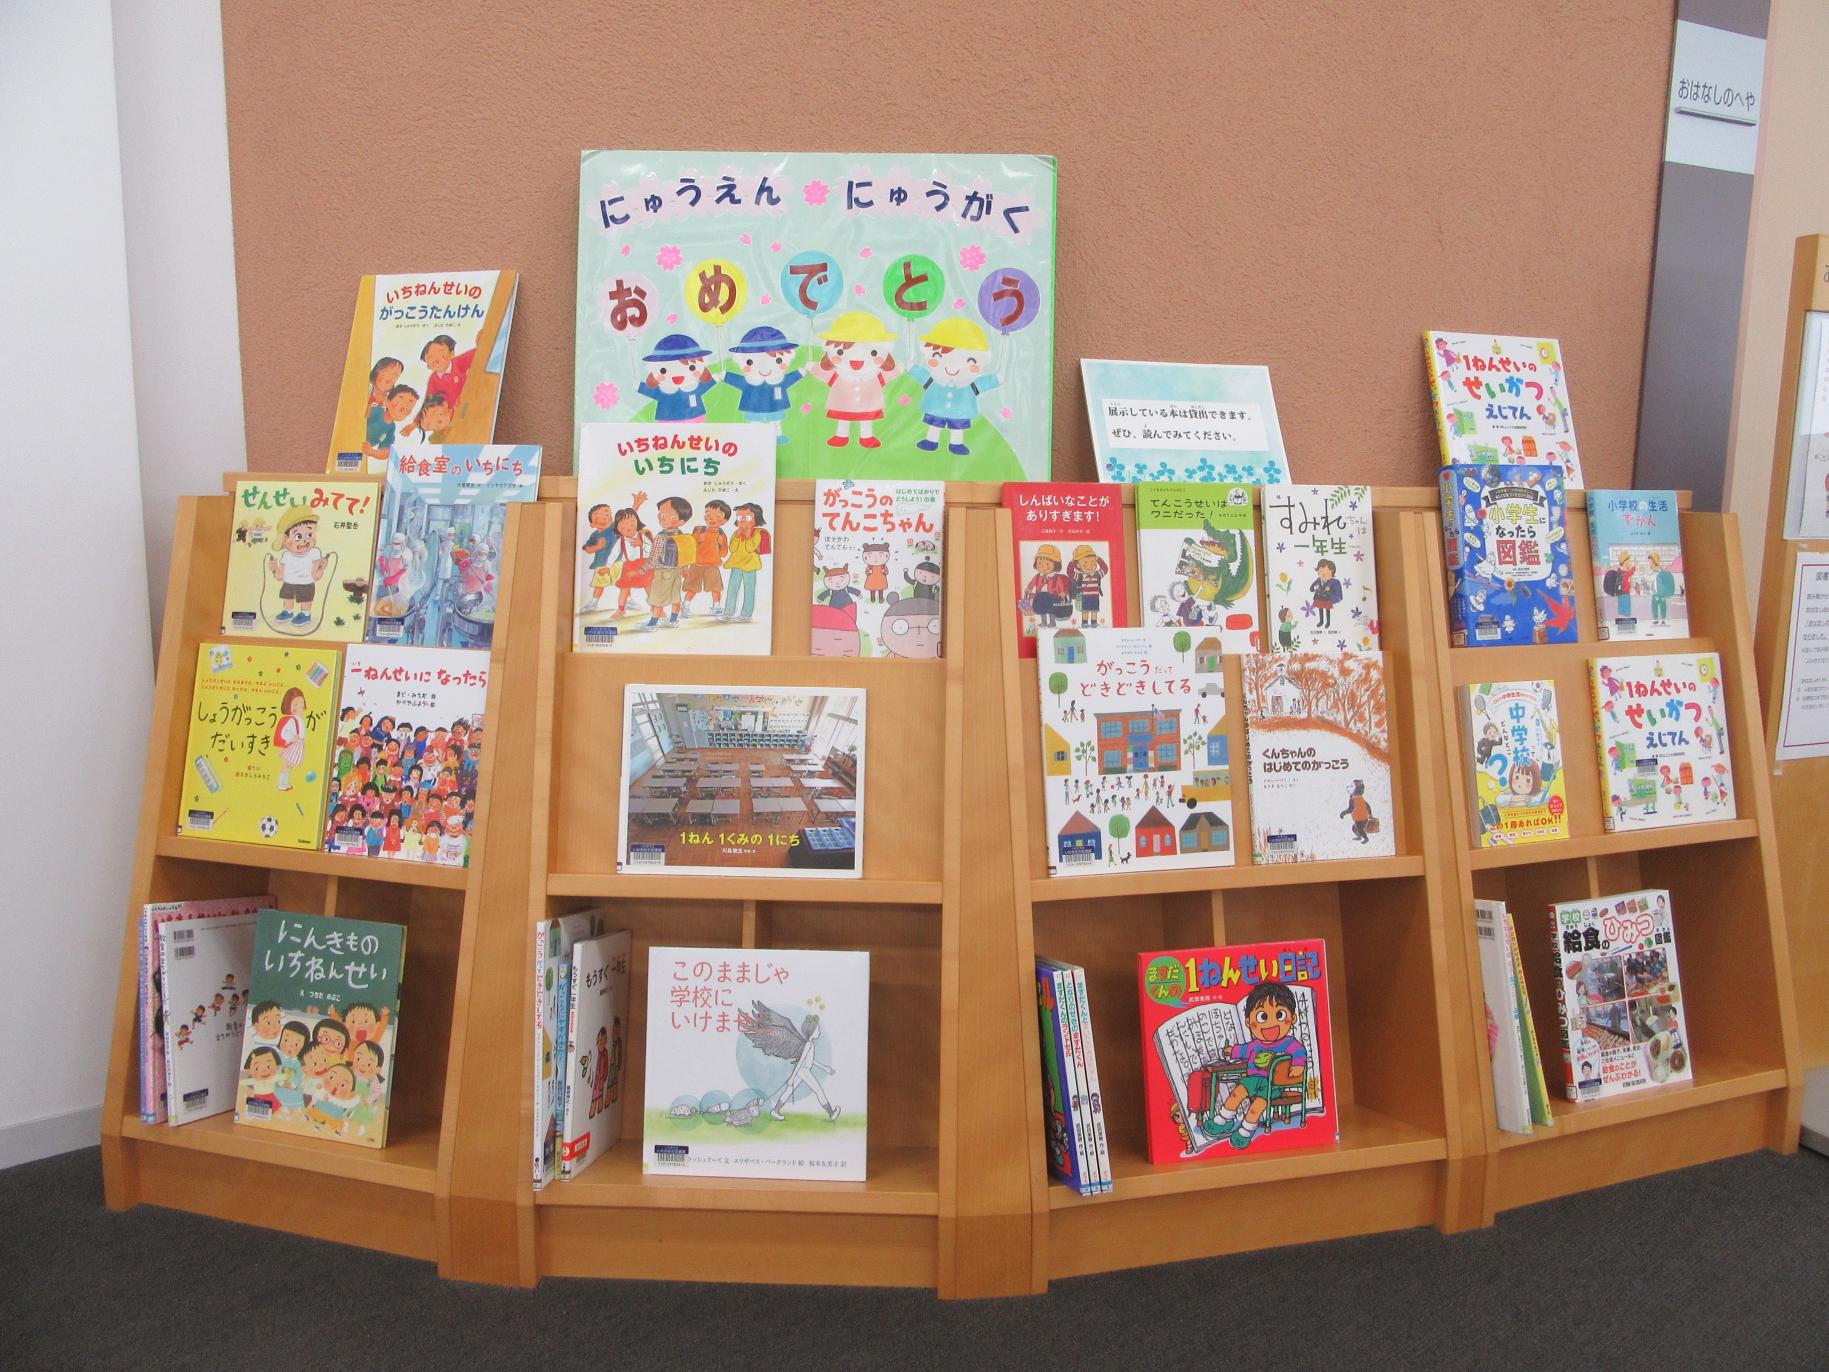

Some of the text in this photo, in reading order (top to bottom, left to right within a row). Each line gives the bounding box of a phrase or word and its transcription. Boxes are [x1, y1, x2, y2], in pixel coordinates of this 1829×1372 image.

[1678, 78, 1756, 111] おはなしのへや
[600, 176, 1030, 234] にゅうえん にゅうがく
[386, 281, 482, 304] いちねんせいの
[608, 261, 1026, 332] おめでとう
[379, 303, 484, 321] がっこうたんけん
[1463, 355, 1537, 373] 1ねんせいの
[1463, 375, 1544, 401] せいかつ
[1108, 405, 1251, 421] 展示している本は貸出できます。
[1485, 403, 1532, 420] えじてん
[617, 434, 739, 457] いちねんせいの
[1111, 429, 1236, 442] ぜひ、読んでみてください。
[399, 455, 523, 477] 給食室のいちにち
[634, 456, 721, 476] いちにち
[823, 488, 894, 509] がっこうの
[1150, 499, 1228, 508] てんこうせいは
[1608, 499, 1668, 512] 小学校の生活
[822, 510, 934, 534] てんこちゃん
[1026, 510, 1100, 522] ありすぎます!
[1151, 510, 1213, 519] ワニだった!
[1269, 496, 1347, 535] すみれ
[1488, 504, 1546, 524] 小学生に
[1495, 525, 1537, 538] なったら
[1294, 534, 1347, 556] 一年生
[1496, 539, 1541, 566] 図鑑
[351, 666, 487, 688] 一ねんせいに なったら
[1096, 659, 1150, 676] がっこう
[1080, 678, 1192, 698] どきどきしてる
[1625, 678, 1697, 698] 1ねんせいの
[198, 702, 327, 731] しょうがっこう が
[1625, 698, 1703, 729] せいかつ
[210, 732, 271, 756] だいすき
[1508, 702, 1530, 766] 中学校
[1646, 730, 1689, 749] えじてん
[1262, 747, 1316, 760] くんちゃんの
[1263, 758, 1350, 773] はじめてのがっこう
[680, 831, 801, 847] 1ねん 1くみの 1にち
[277, 919, 379, 956] にんきもの
[1563, 926, 1610, 954] 給食の
[1603, 913, 1655, 944] ひみつ
[264, 949, 387, 989] いちねんせい
[672, 961, 790, 984] このままじゃ
[1185, 951, 1322, 993] 1ねんせい日記
[670, 986, 733, 1008] 学校に
